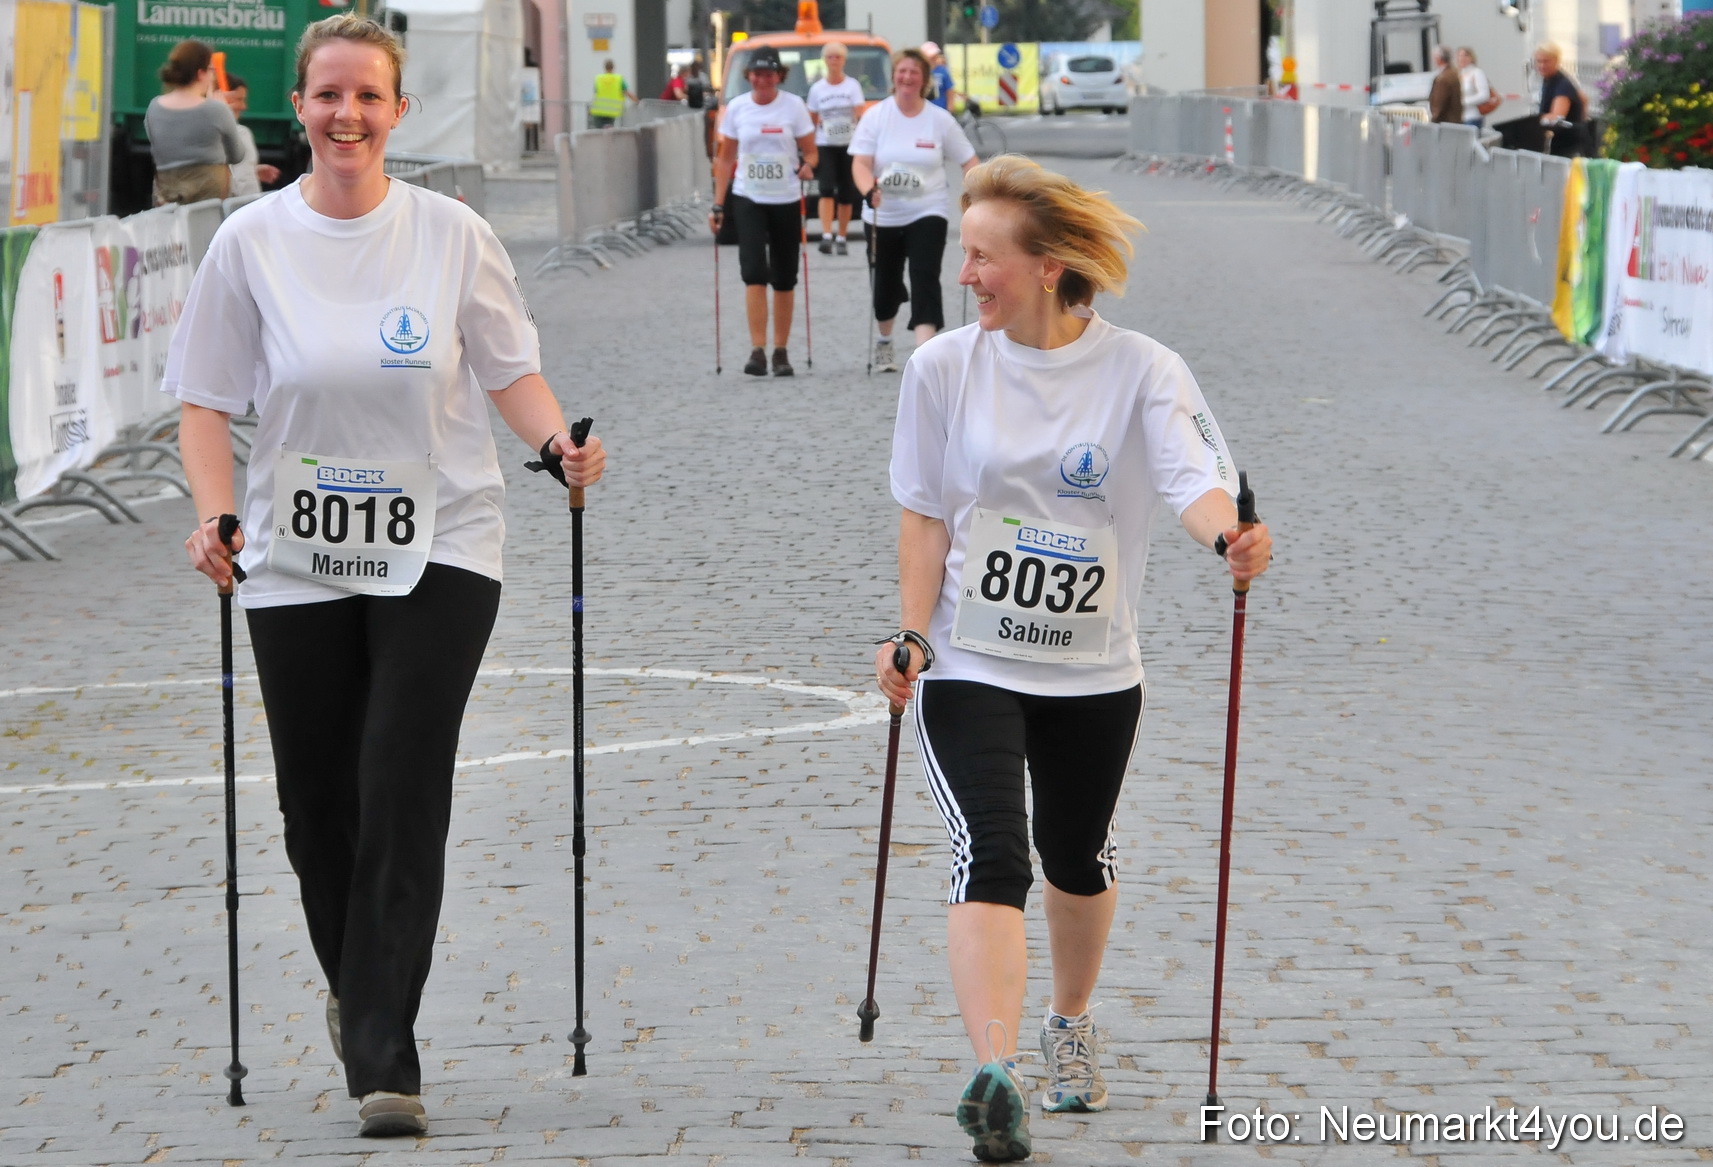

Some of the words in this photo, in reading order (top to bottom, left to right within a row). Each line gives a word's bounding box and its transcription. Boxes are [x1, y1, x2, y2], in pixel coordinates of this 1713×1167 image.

[137, 0, 285, 29] Lammsbräu
[748, 163, 784, 180] 8083
[405, 358, 431, 366] Runners
[316, 466, 385, 485] BOCK
[291, 489, 416, 546] 8018
[1017, 526, 1088, 553] BOCK
[311, 552, 389, 579] Marina
[980, 550, 1106, 614] 8032
[998, 616, 1074, 647] Sabine
